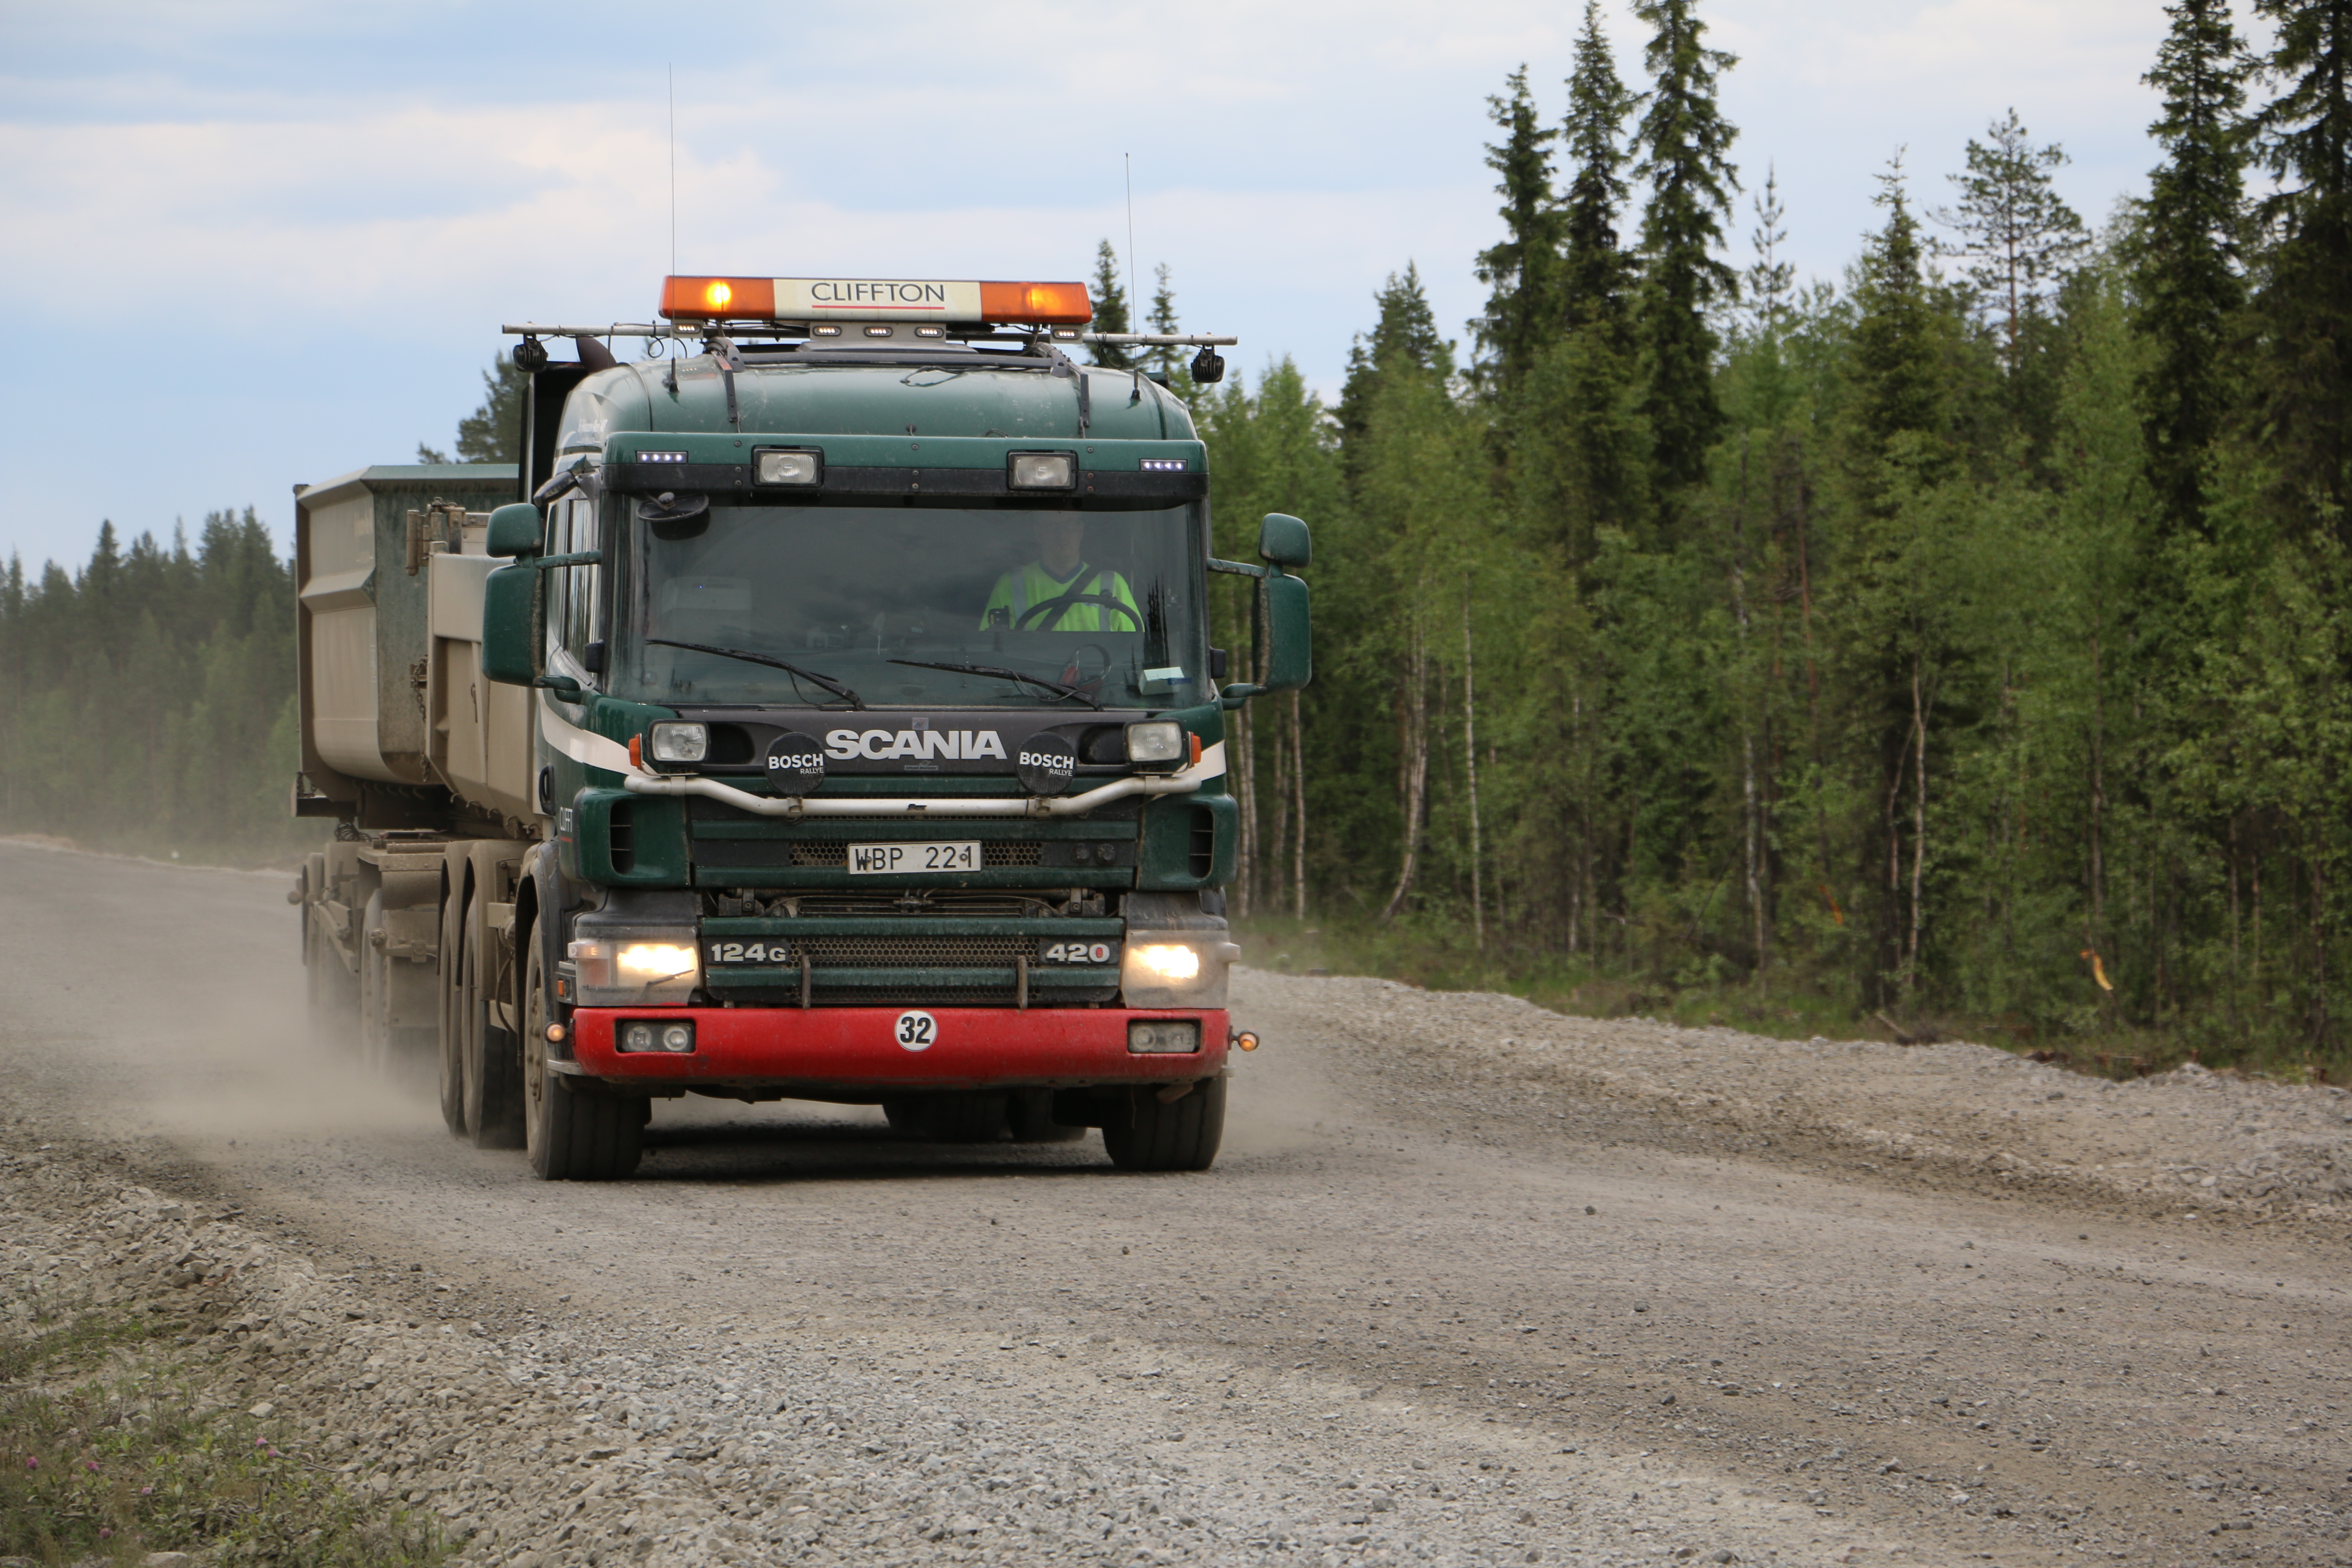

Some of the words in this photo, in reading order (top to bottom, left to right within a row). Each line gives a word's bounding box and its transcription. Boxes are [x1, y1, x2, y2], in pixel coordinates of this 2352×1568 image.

[812, 282, 945, 302] CLIFFTON
[825, 729, 1008, 760] SCANIA
[769, 753, 824, 769] BOSCH
[1019, 751, 1074, 769] BOSCH
[1049, 769, 1073, 777] RALLYE
[855, 847, 903, 871] WBP
[925, 845, 972, 869] 221
[1046, 943, 1110, 962] 420
[900, 1016, 931, 1044] 32
